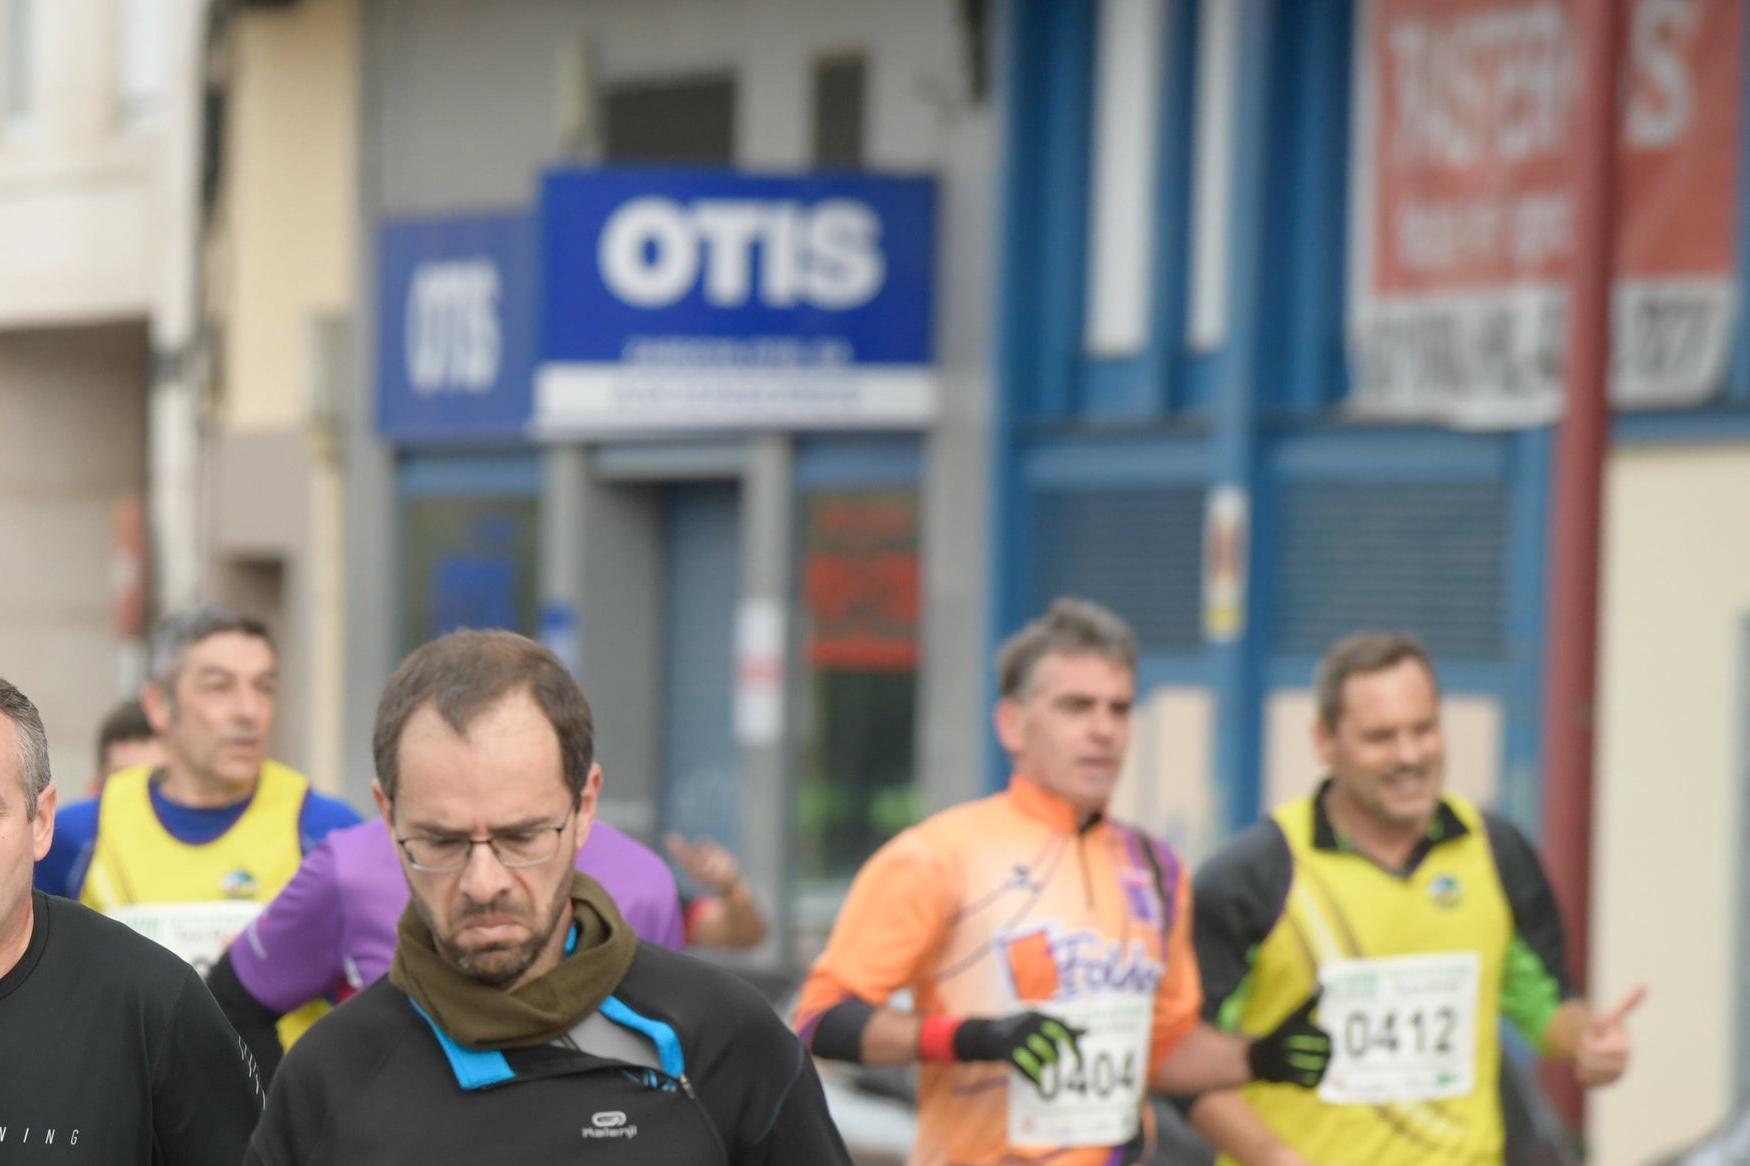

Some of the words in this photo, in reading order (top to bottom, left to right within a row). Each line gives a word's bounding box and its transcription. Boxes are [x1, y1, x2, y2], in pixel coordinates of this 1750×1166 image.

[598, 195, 886, 309] OTIS
[407, 259, 502, 393] OTIS
[1345, 1007, 1458, 1059] 0412
